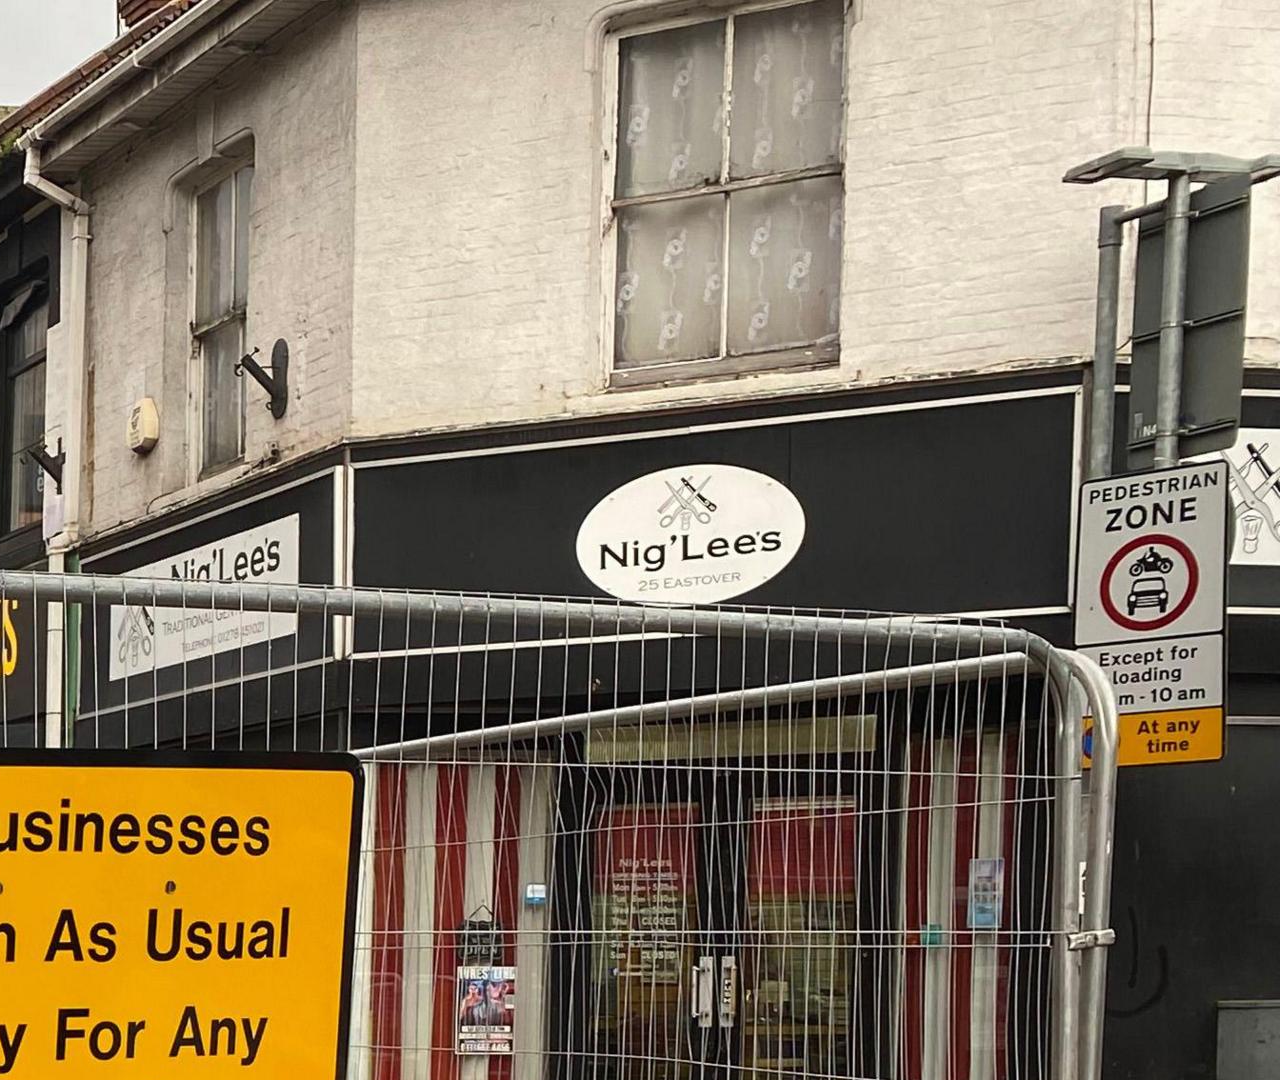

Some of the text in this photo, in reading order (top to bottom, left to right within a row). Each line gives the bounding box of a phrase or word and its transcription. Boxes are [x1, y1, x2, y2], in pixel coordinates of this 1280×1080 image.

[1090, 471, 1219, 504] PEDESTRIAN
[1105, 497, 1198, 533] ZONE
[638, 572, 742, 592] 25 EASTOVER
[1100, 646, 1198, 668] Except for
[1113, 665, 1182, 685] loading
[1151, 687, 1170, 703] 10
[1178, 687, 1206, 701] am
[1137, 720, 1200, 736] At any
[1147, 738, 1189, 754] time
[45, 908, 117, 963] As
[146, 907, 290, 962] Usual
[55, 1008, 145, 1061] For
[169, 1005, 268, 1066] Any
